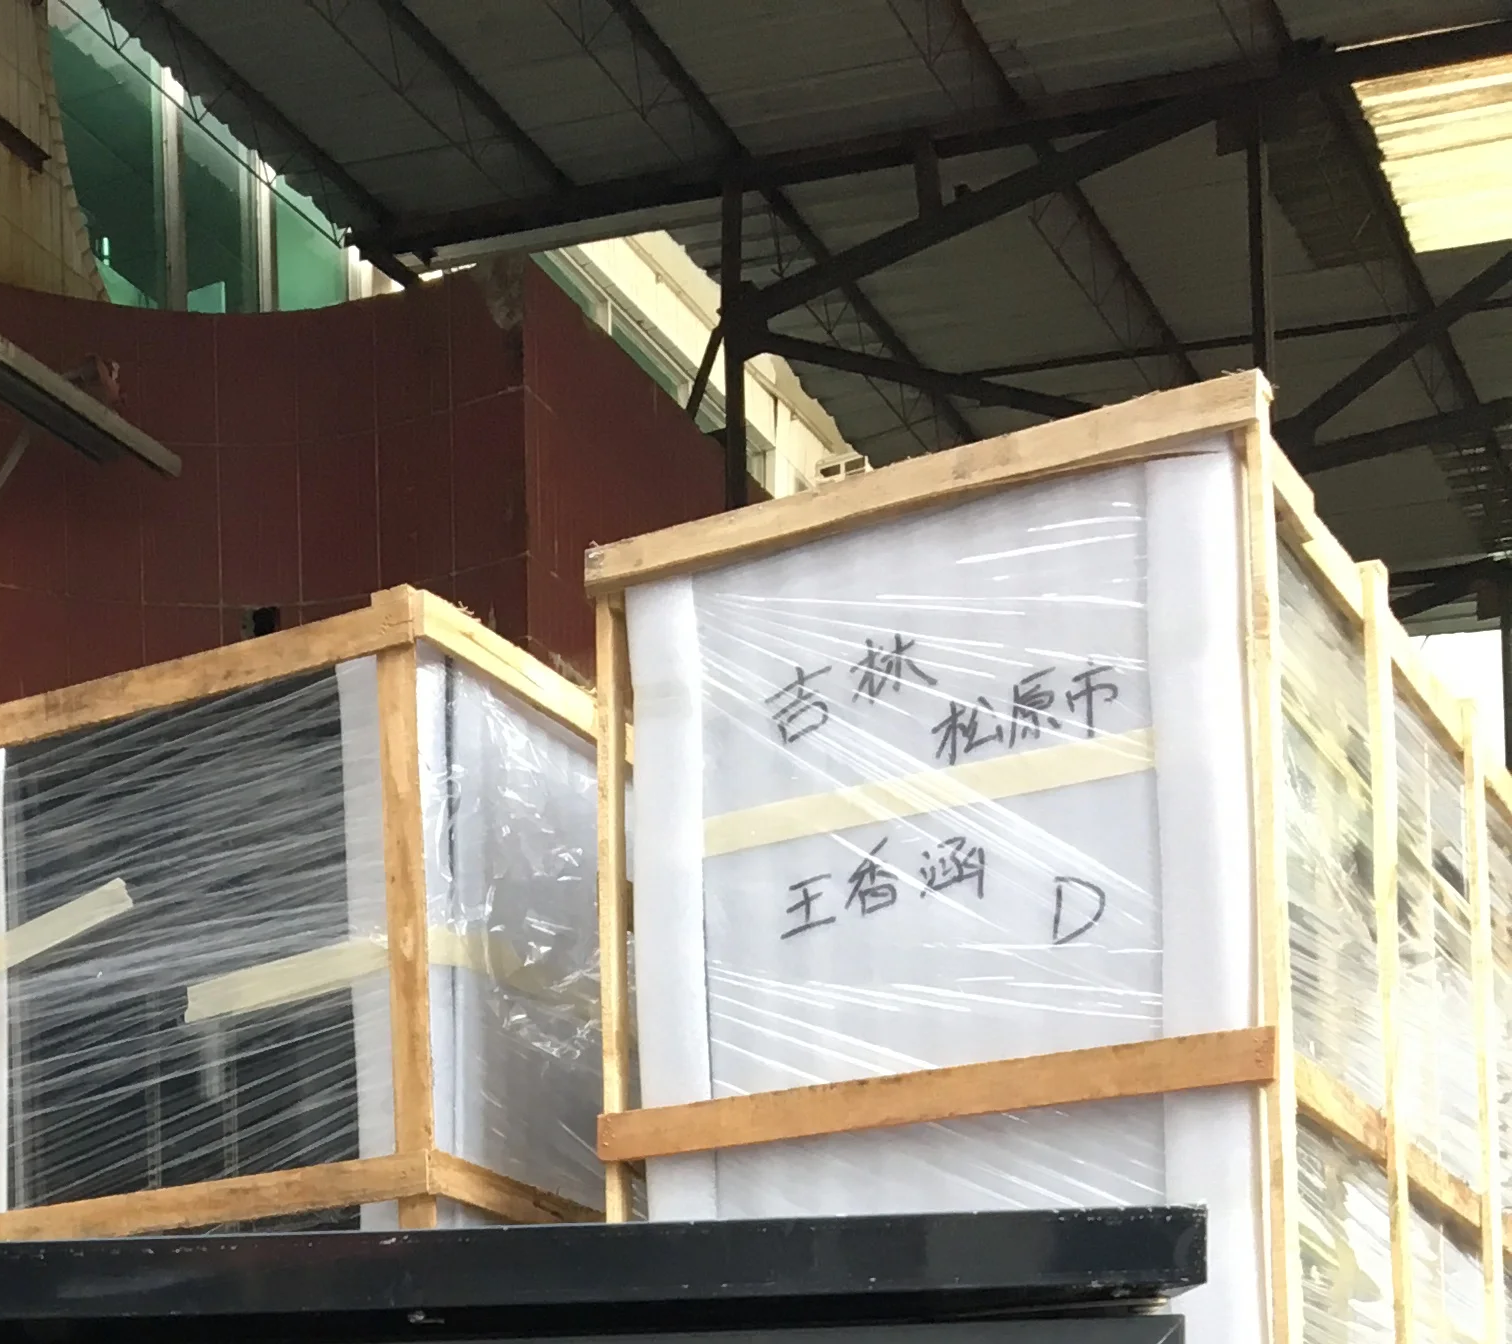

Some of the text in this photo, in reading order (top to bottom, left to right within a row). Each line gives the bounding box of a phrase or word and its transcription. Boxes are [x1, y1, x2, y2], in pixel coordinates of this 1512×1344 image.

[765, 633, 1119, 766] 吉林 松原市
[1052, 876, 1106, 946] D
